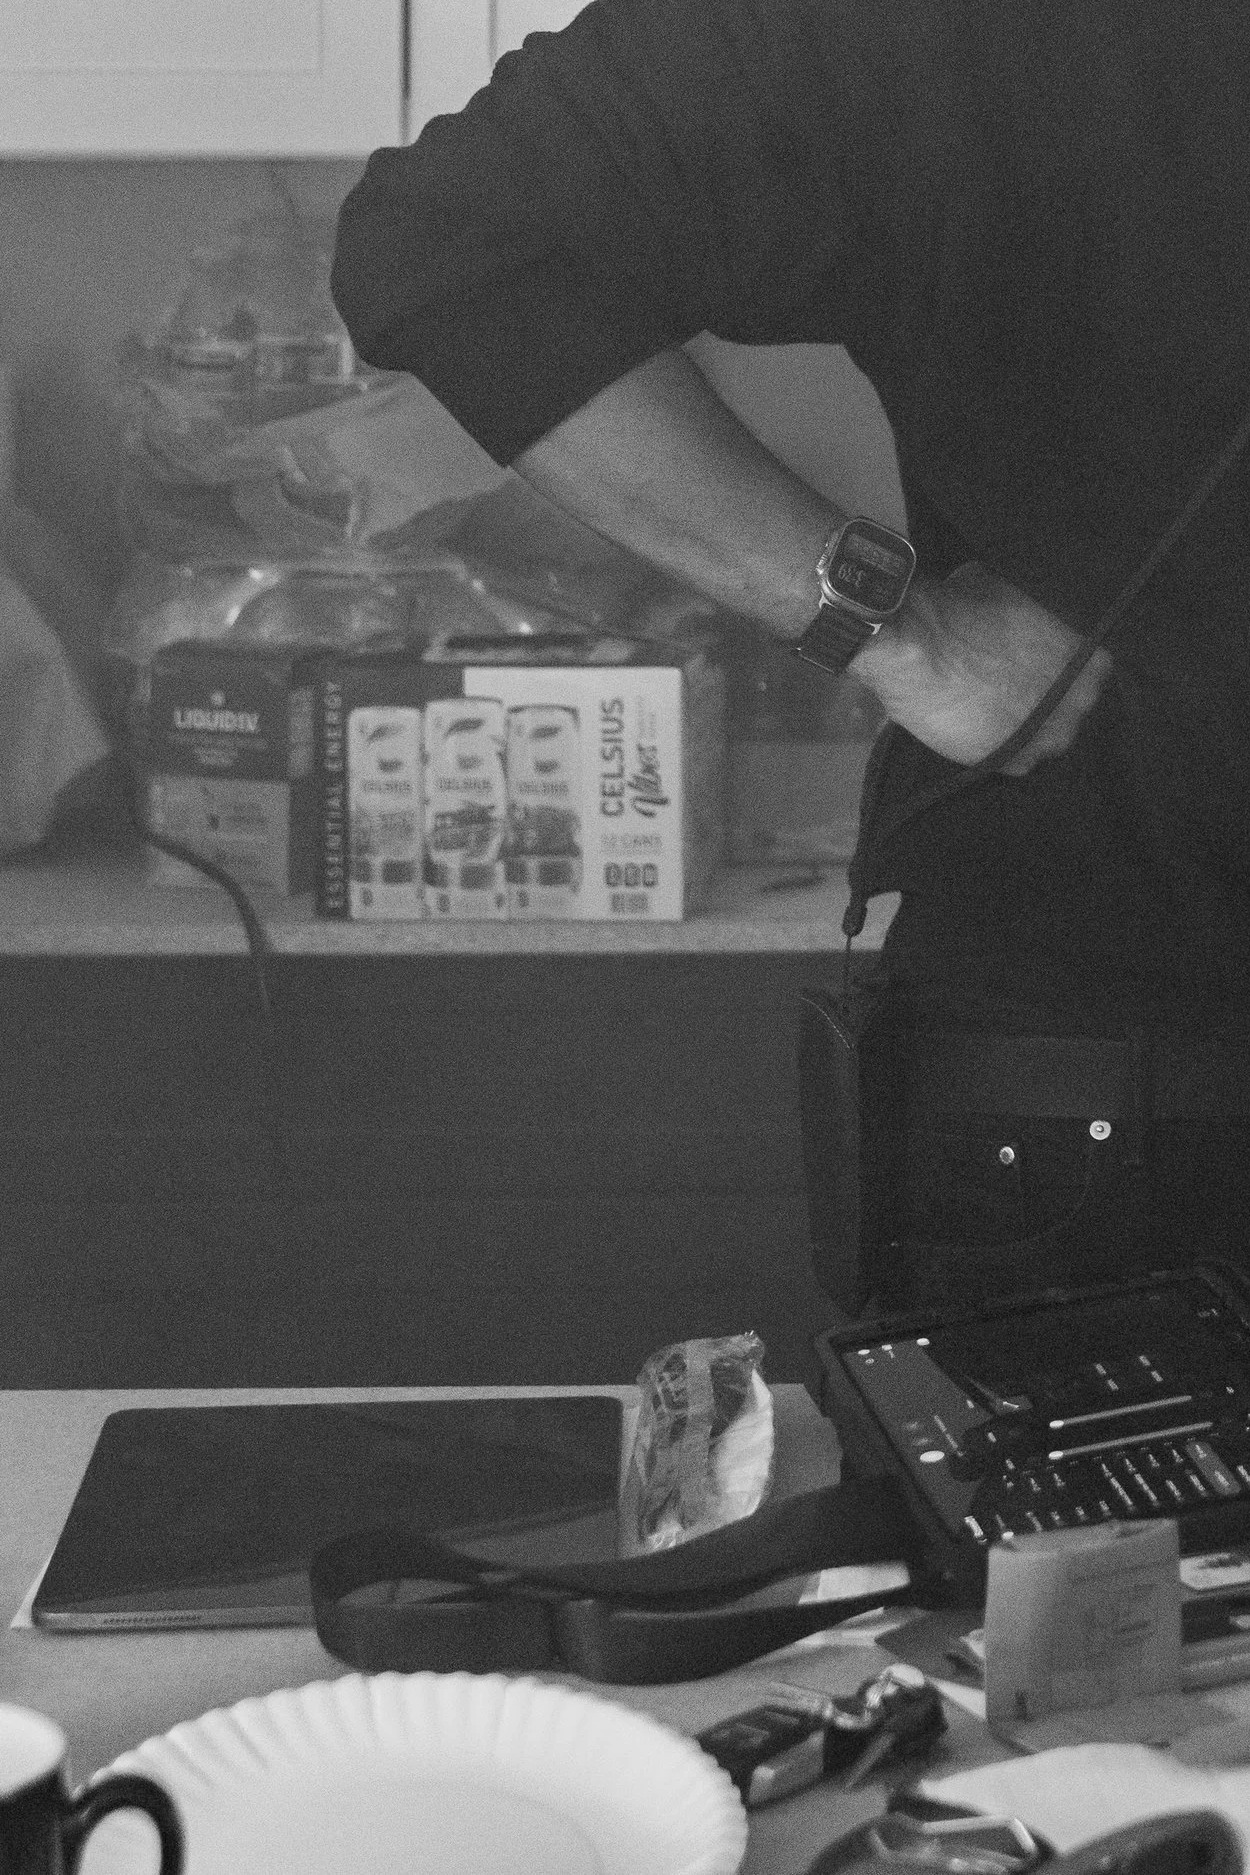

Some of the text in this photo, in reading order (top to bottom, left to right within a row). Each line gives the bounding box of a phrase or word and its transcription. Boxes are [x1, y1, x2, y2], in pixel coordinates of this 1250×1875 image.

[323, 681, 344, 910] ESSENTIAL ENERGY
[599, 698, 625, 818] CELSIUS
